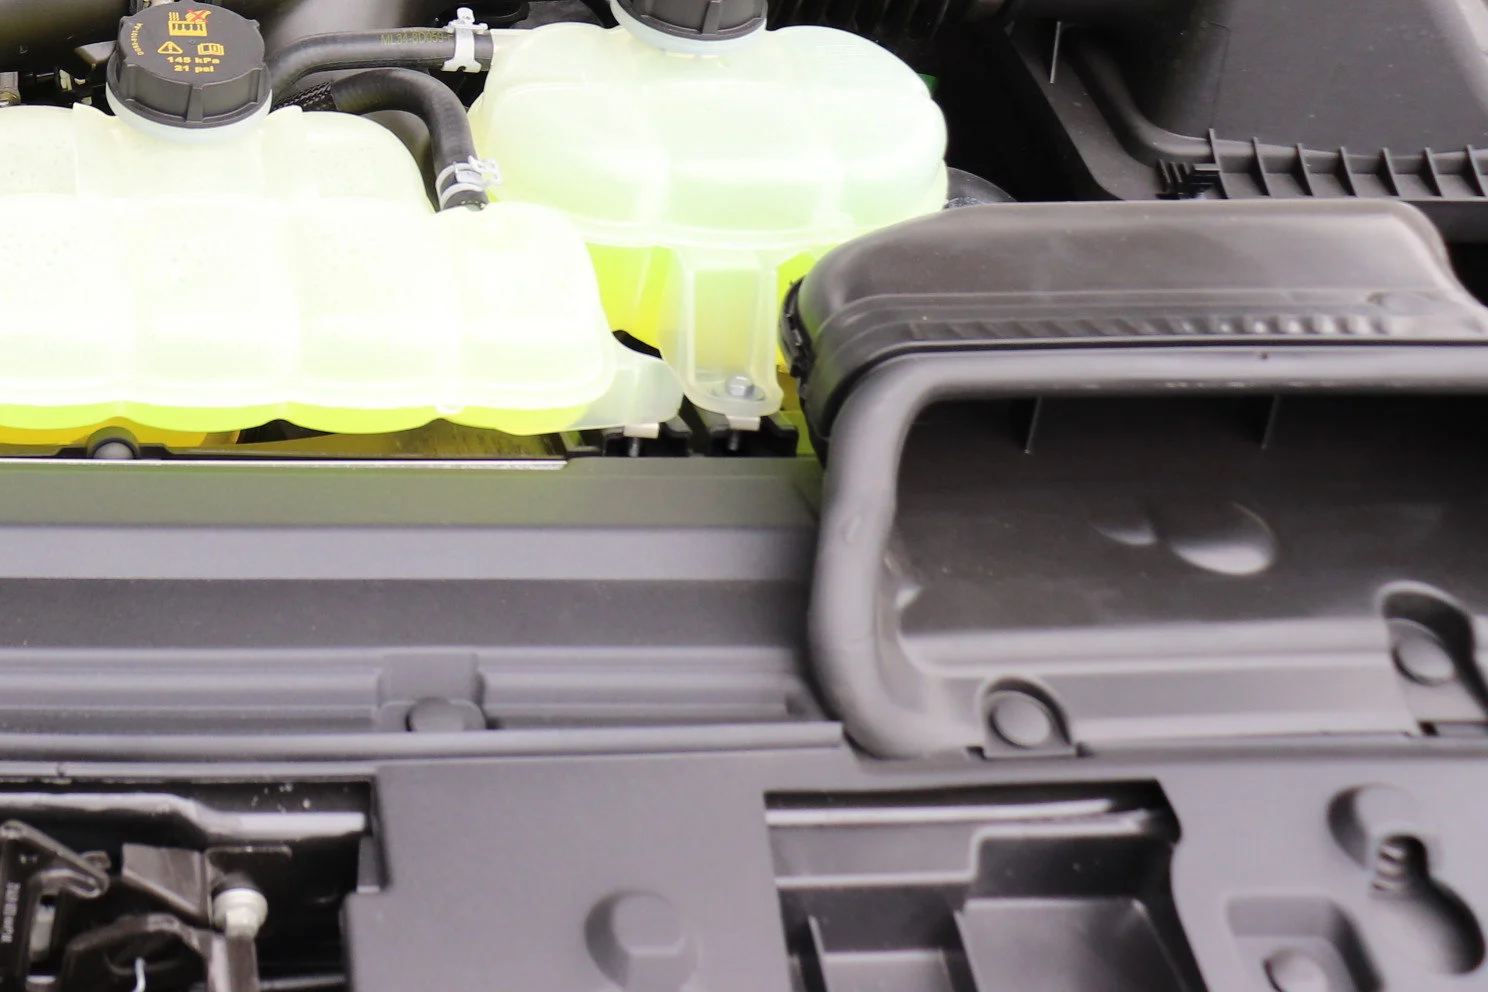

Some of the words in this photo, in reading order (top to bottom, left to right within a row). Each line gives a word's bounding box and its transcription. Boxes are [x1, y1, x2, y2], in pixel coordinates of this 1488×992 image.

[167, 56, 192, 64] 145
[194, 57, 220, 65] kPa
[174, 64, 189, 72] 21
[195, 65, 215, 74] psi
